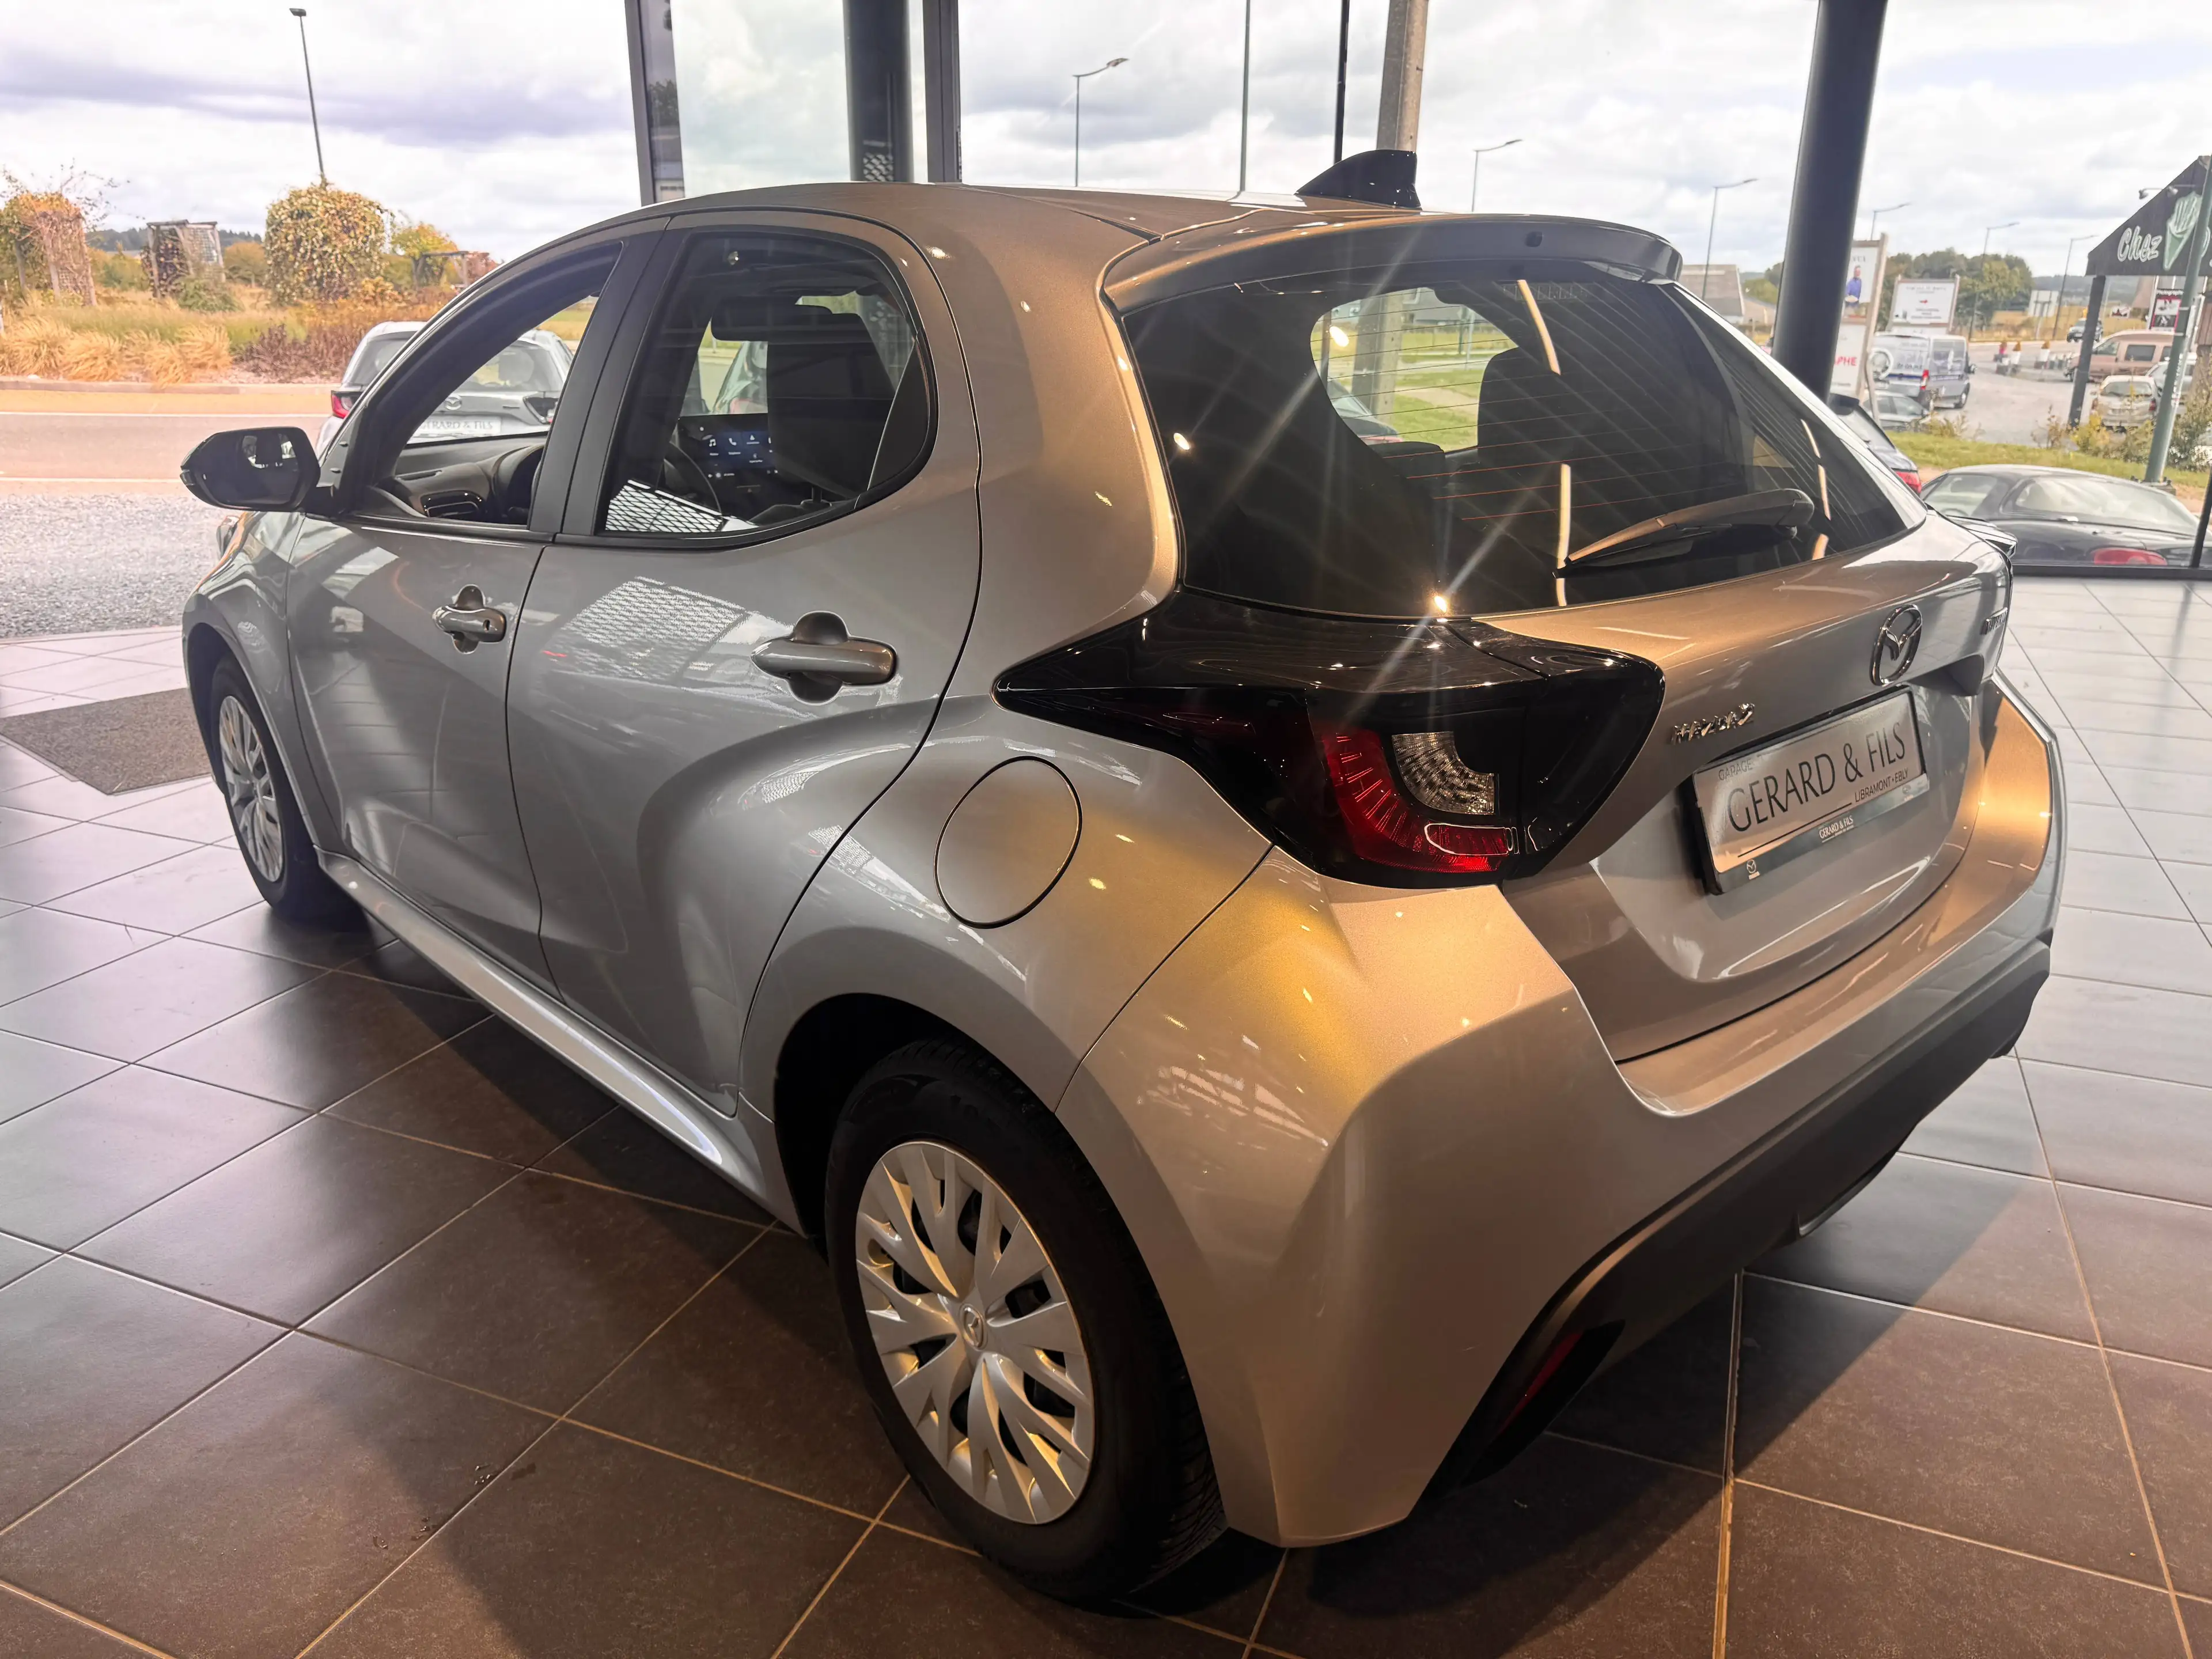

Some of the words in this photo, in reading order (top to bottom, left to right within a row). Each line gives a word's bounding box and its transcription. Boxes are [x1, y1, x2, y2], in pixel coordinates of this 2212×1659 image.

[2117, 226, 2162, 262] Chez
[1718, 758, 1753, 781] GARAGE
[1728, 753, 1836, 832] GERARD
[1843, 743, 1863, 782] &
[1866, 722, 1905, 772] FILS
[1819, 822, 1839, 839] GERARD
[1839, 820, 1844, 830] &
[1843, 815, 1854, 827] FILS
